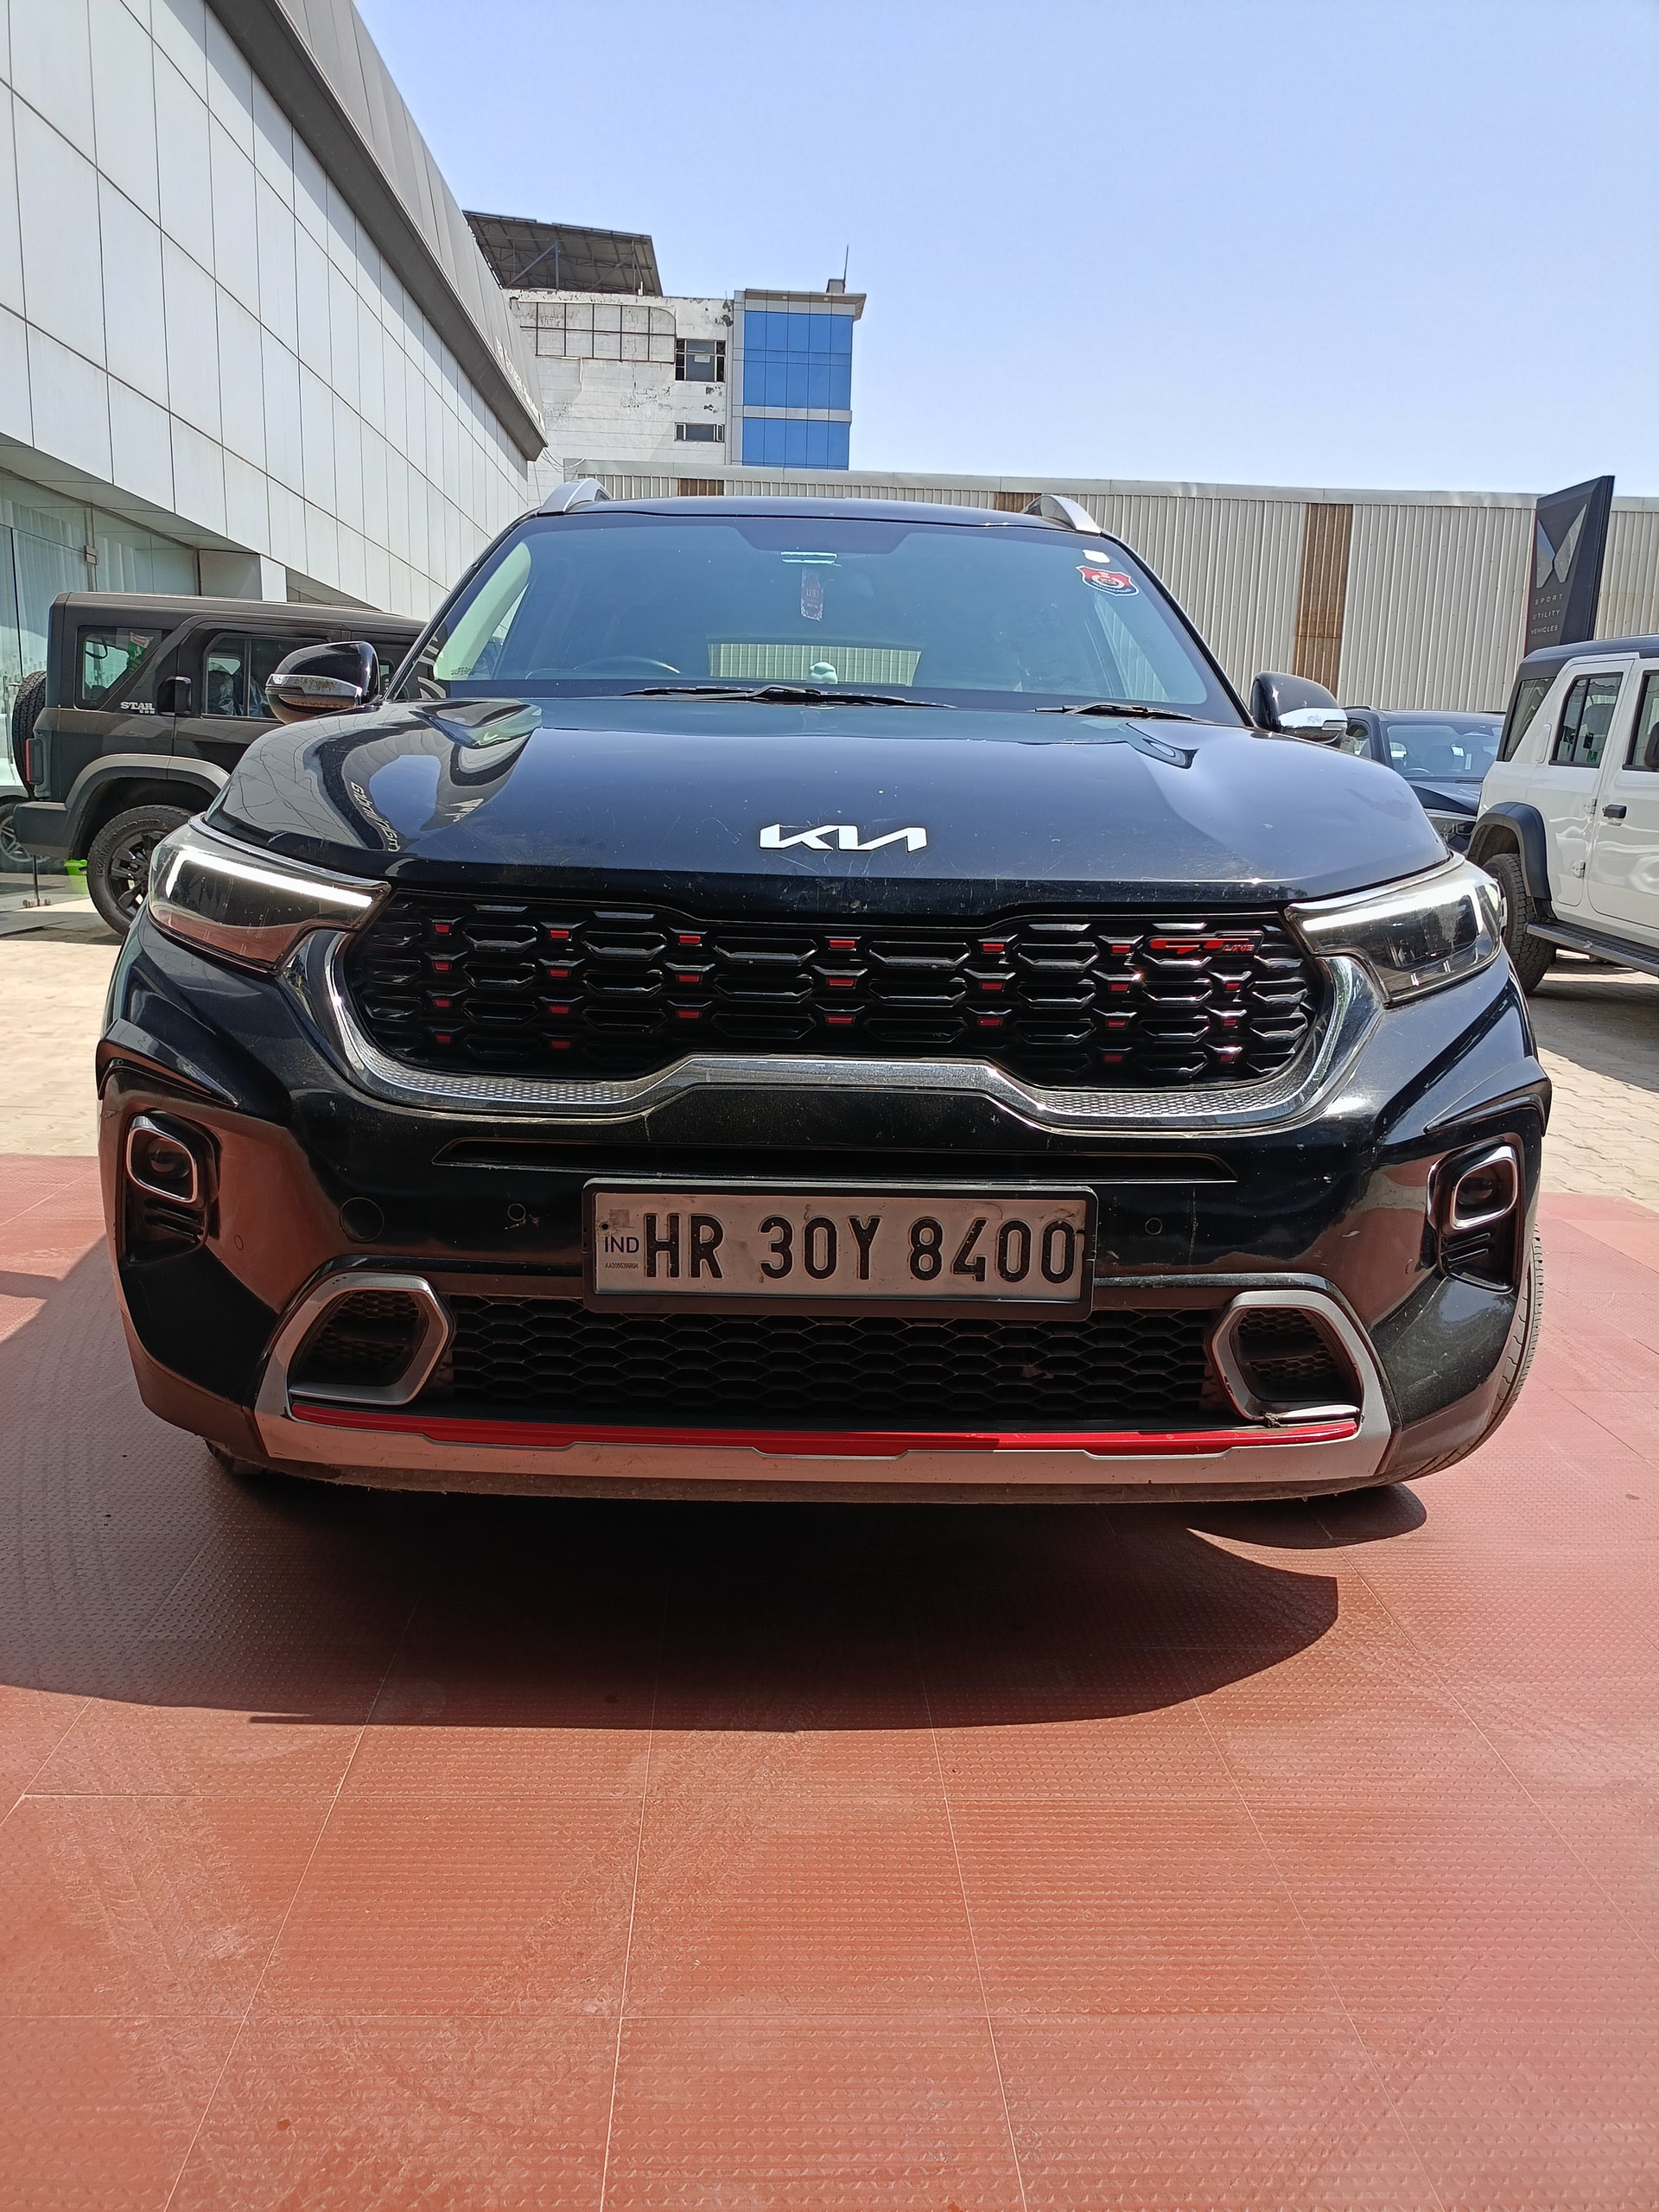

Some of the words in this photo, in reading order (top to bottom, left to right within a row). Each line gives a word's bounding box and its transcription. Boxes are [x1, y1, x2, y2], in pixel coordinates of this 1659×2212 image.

[1535, 594, 1562, 605] SPORT
[1532, 609, 1560, 620] UTILITY
[1531, 625, 1559, 634] VEHICLES
[120, 701, 156, 710] STAR
[759, 823, 927, 853] KIA
[1148, 938, 1249, 955] GT
[1221, 944, 1255, 953] LINE
[604, 1236, 639, 1253] IND
[644, 1212, 725, 1279] HR
[759, 1214, 882, 1281] 30Y
[908, 1215, 1077, 1283] 8400
